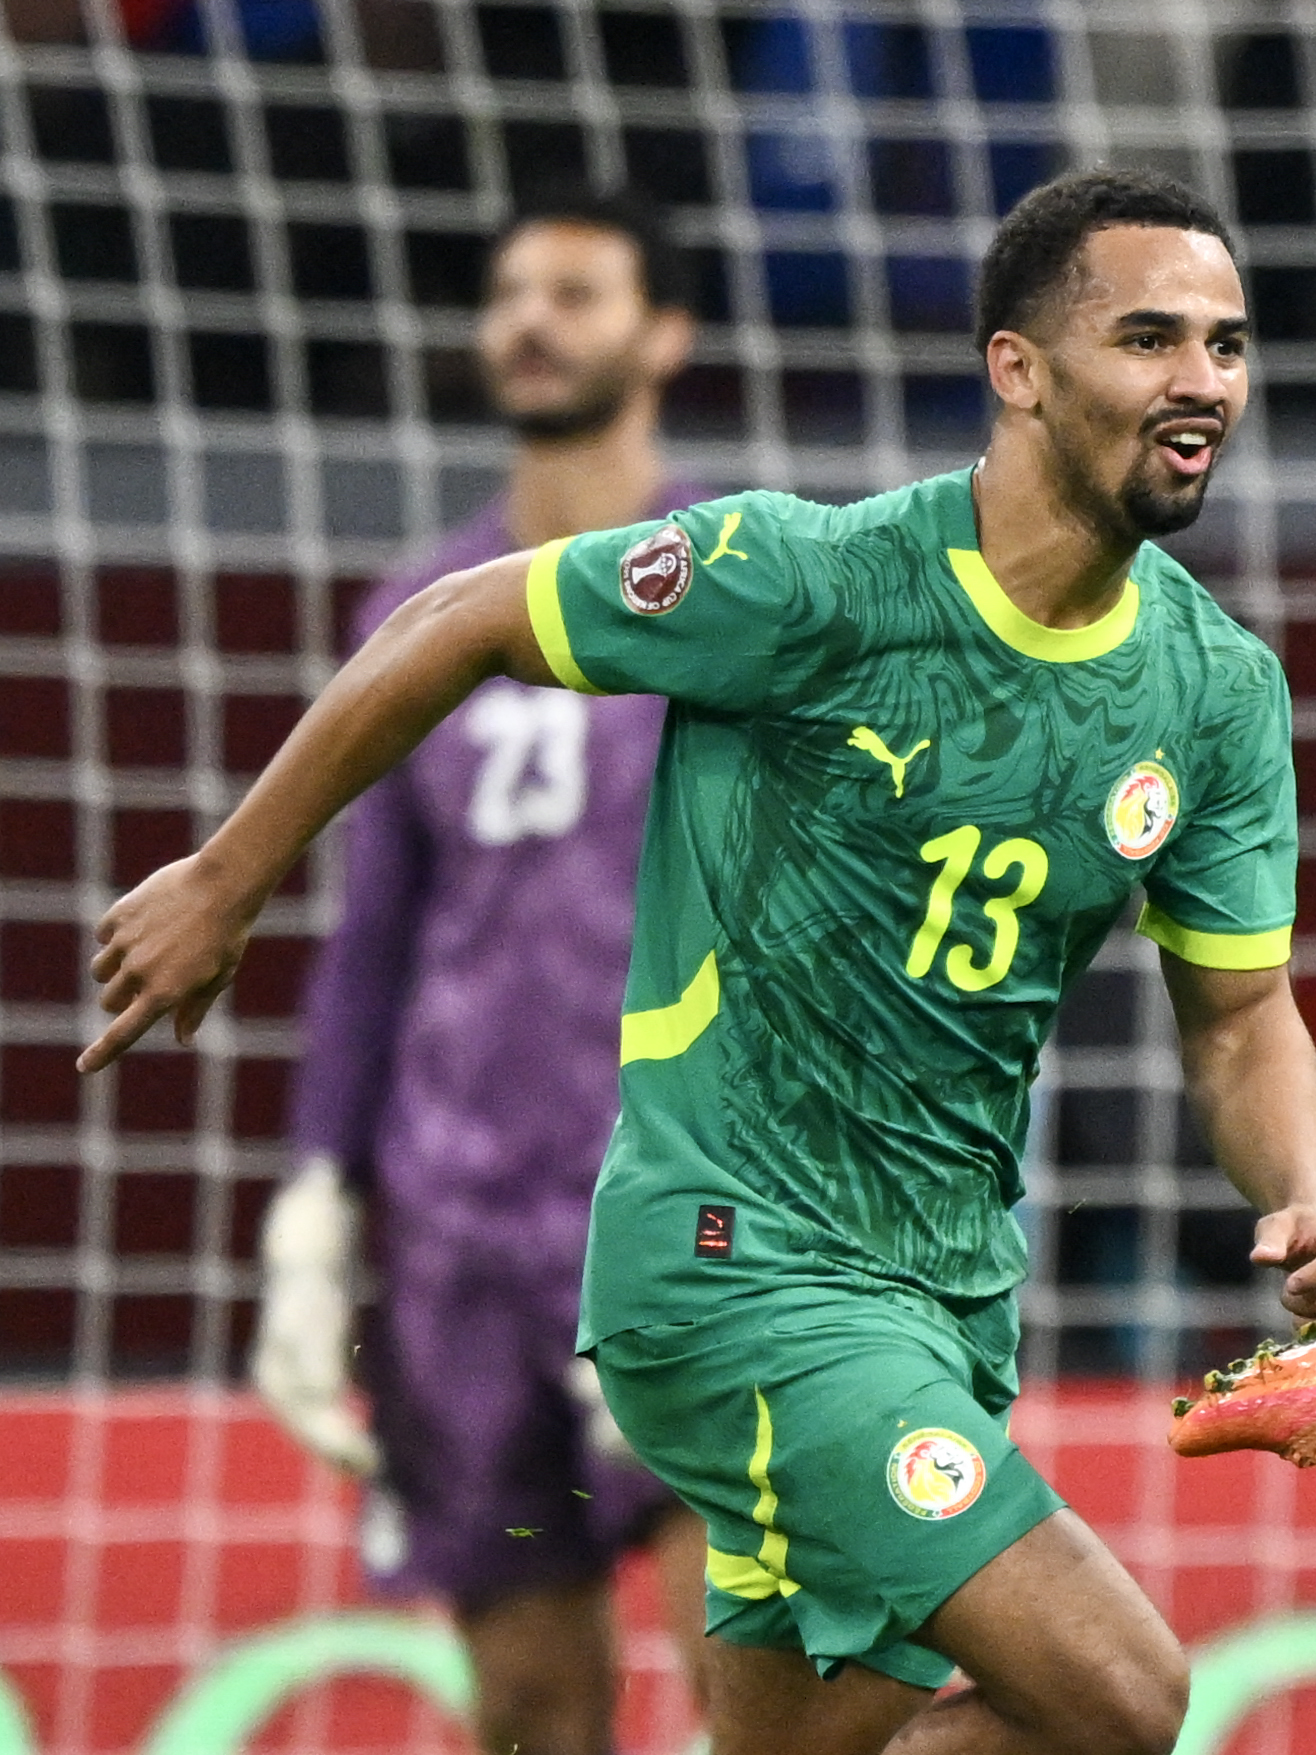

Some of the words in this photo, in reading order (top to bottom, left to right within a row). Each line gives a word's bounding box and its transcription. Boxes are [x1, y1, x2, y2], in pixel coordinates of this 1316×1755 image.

[661, 592, 678, 607] CUP
[465, 686, 588, 845] 23
[906, 825, 1049, 991] 13
